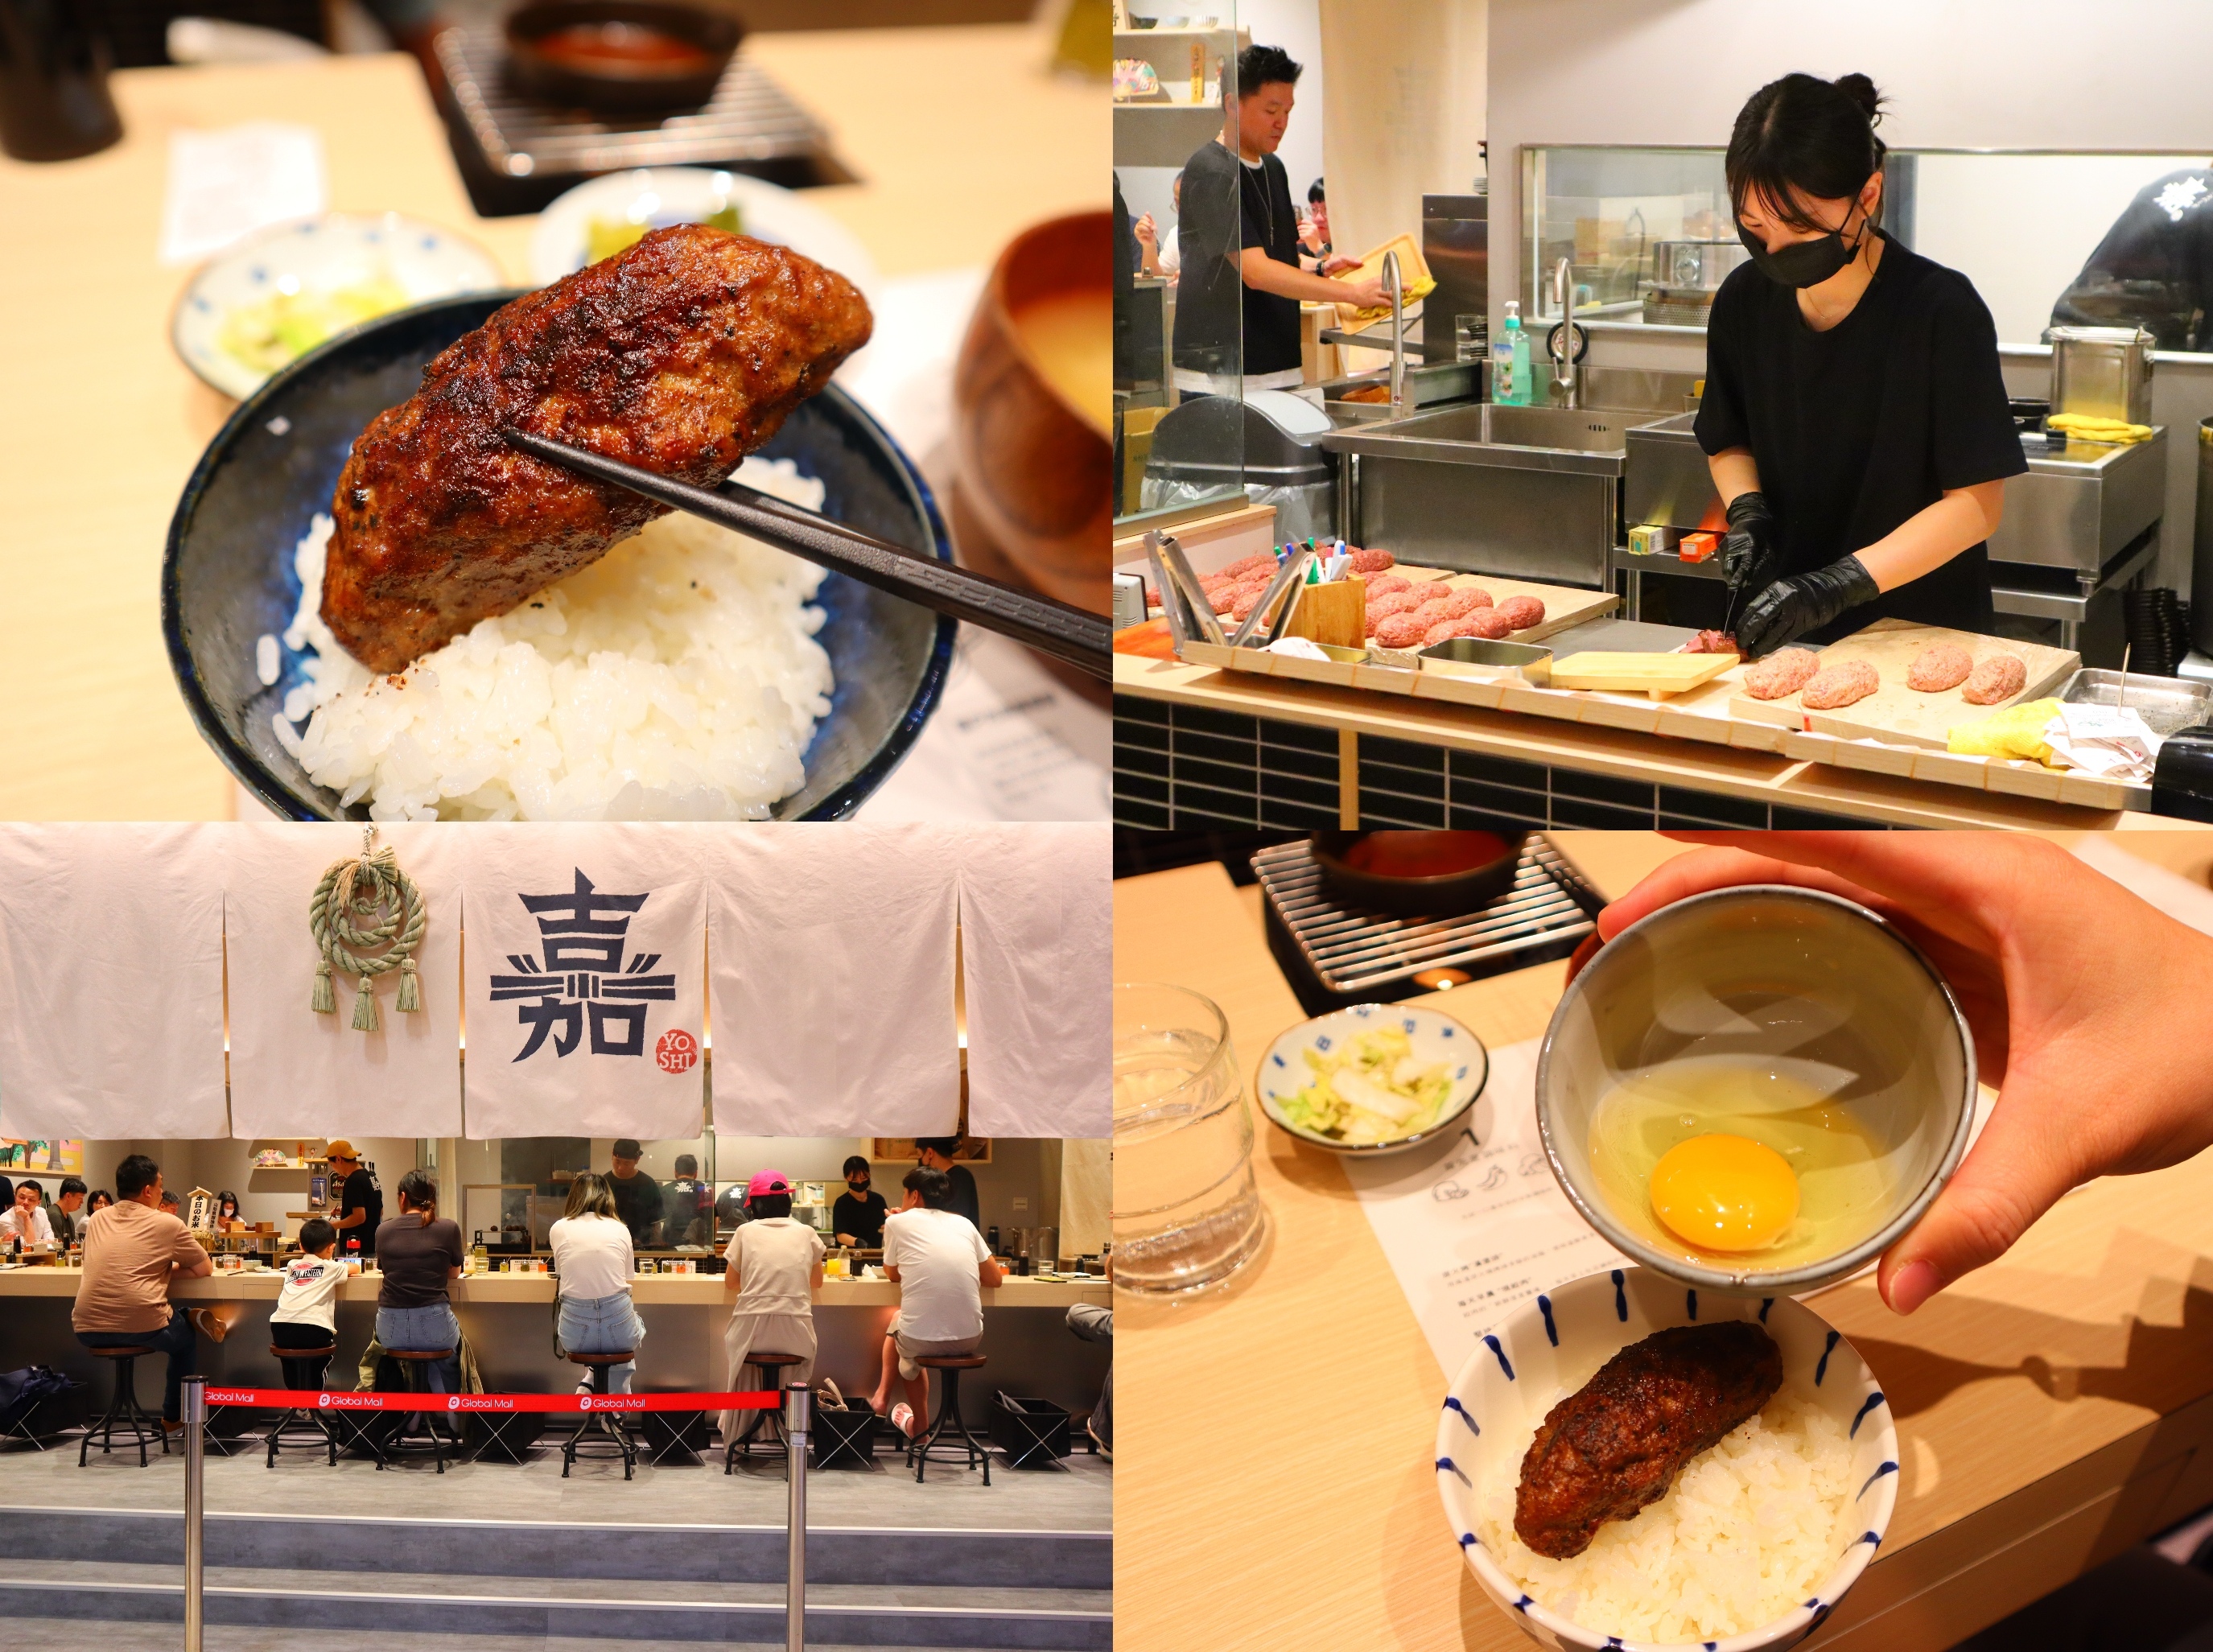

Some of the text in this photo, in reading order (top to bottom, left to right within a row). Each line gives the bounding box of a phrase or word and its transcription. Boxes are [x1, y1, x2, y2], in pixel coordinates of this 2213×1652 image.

[489, 866, 676, 1063] 嘉
[664, 1032, 690, 1051] YO
[659, 1051, 691, 1070] SHI
[192, 1195, 204, 1228] 本日のお米
[299, 1268, 323, 1277] WESTERN
[204, 1391, 254, 1403] Global Mall
[332, 1396, 383, 1407] Global Mall
[461, 1399, 513, 1408] Global Mall
[593, 1399, 645, 1408] Global Mall
